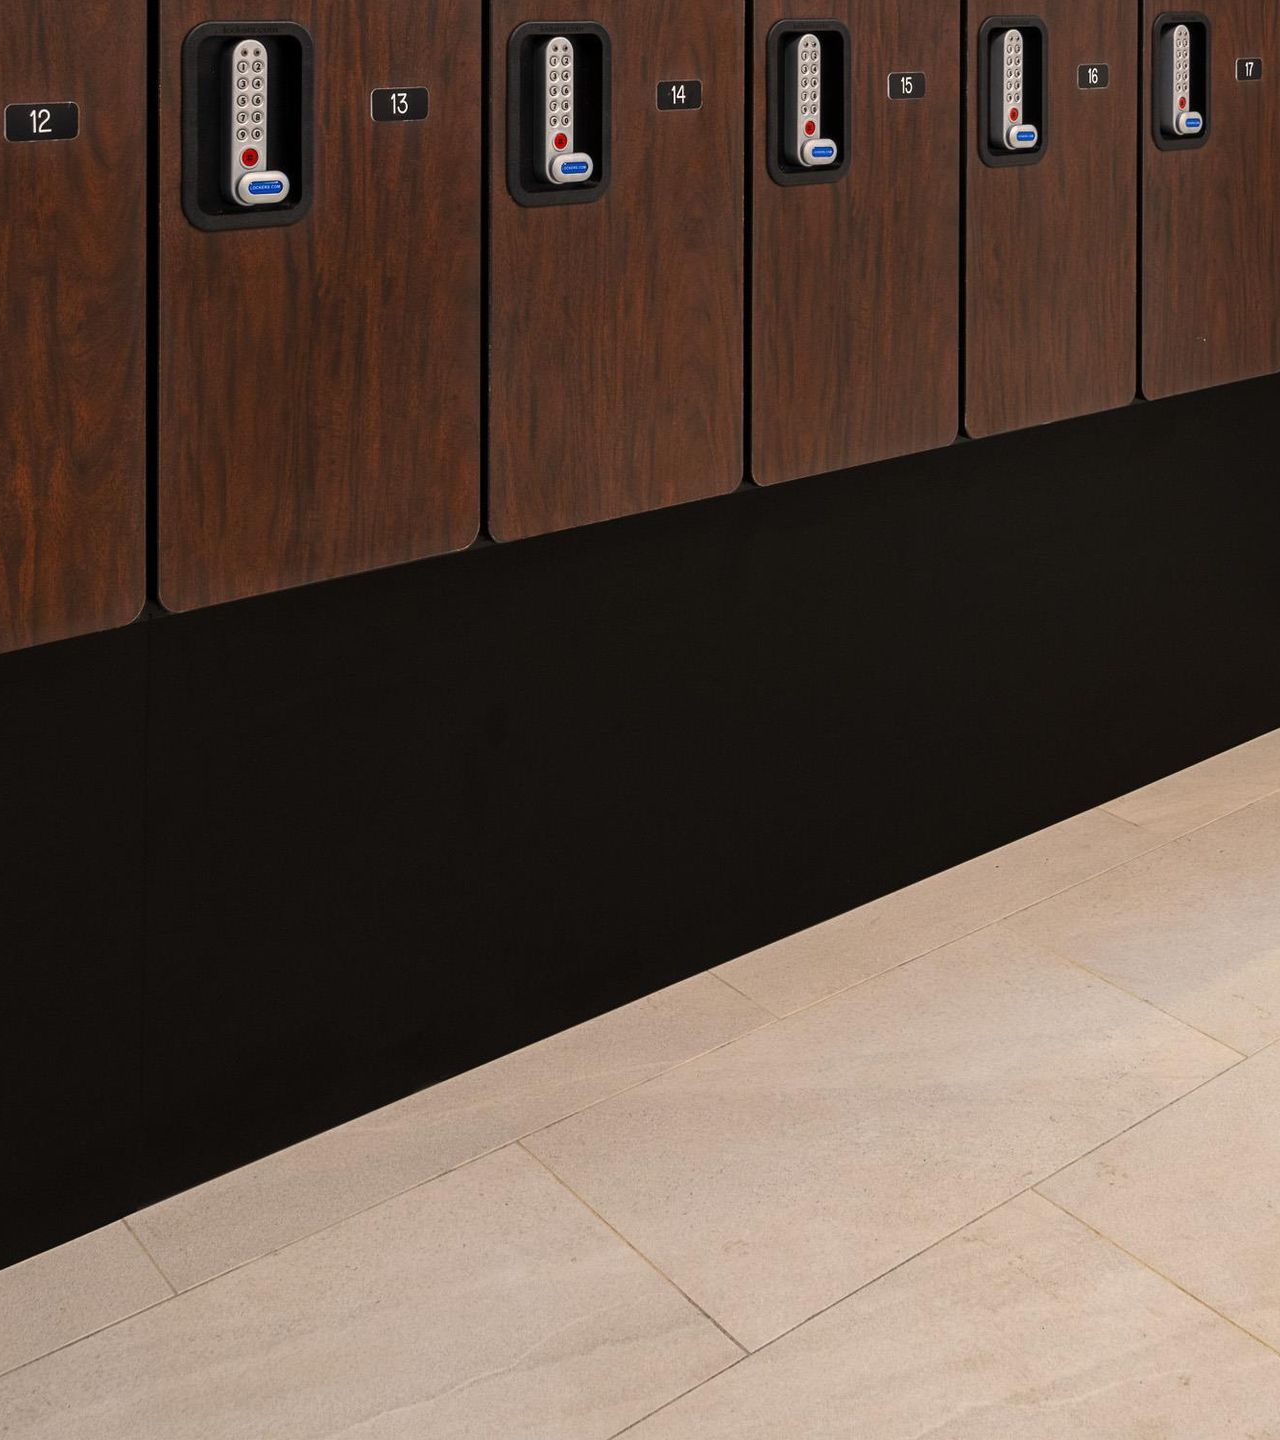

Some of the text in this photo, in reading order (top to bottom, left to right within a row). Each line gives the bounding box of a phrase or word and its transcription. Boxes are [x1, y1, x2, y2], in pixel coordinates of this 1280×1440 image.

[1087, 68, 1098, 84] 16
[1245, 63, 1254, 77] 17
[901, 77, 913, 94] 15
[670, 85, 686, 104] 14
[391, 93, 409, 114] 13
[29, 109, 52, 133] 12
[250, 183, 281, 191] LOCKERS.COM
